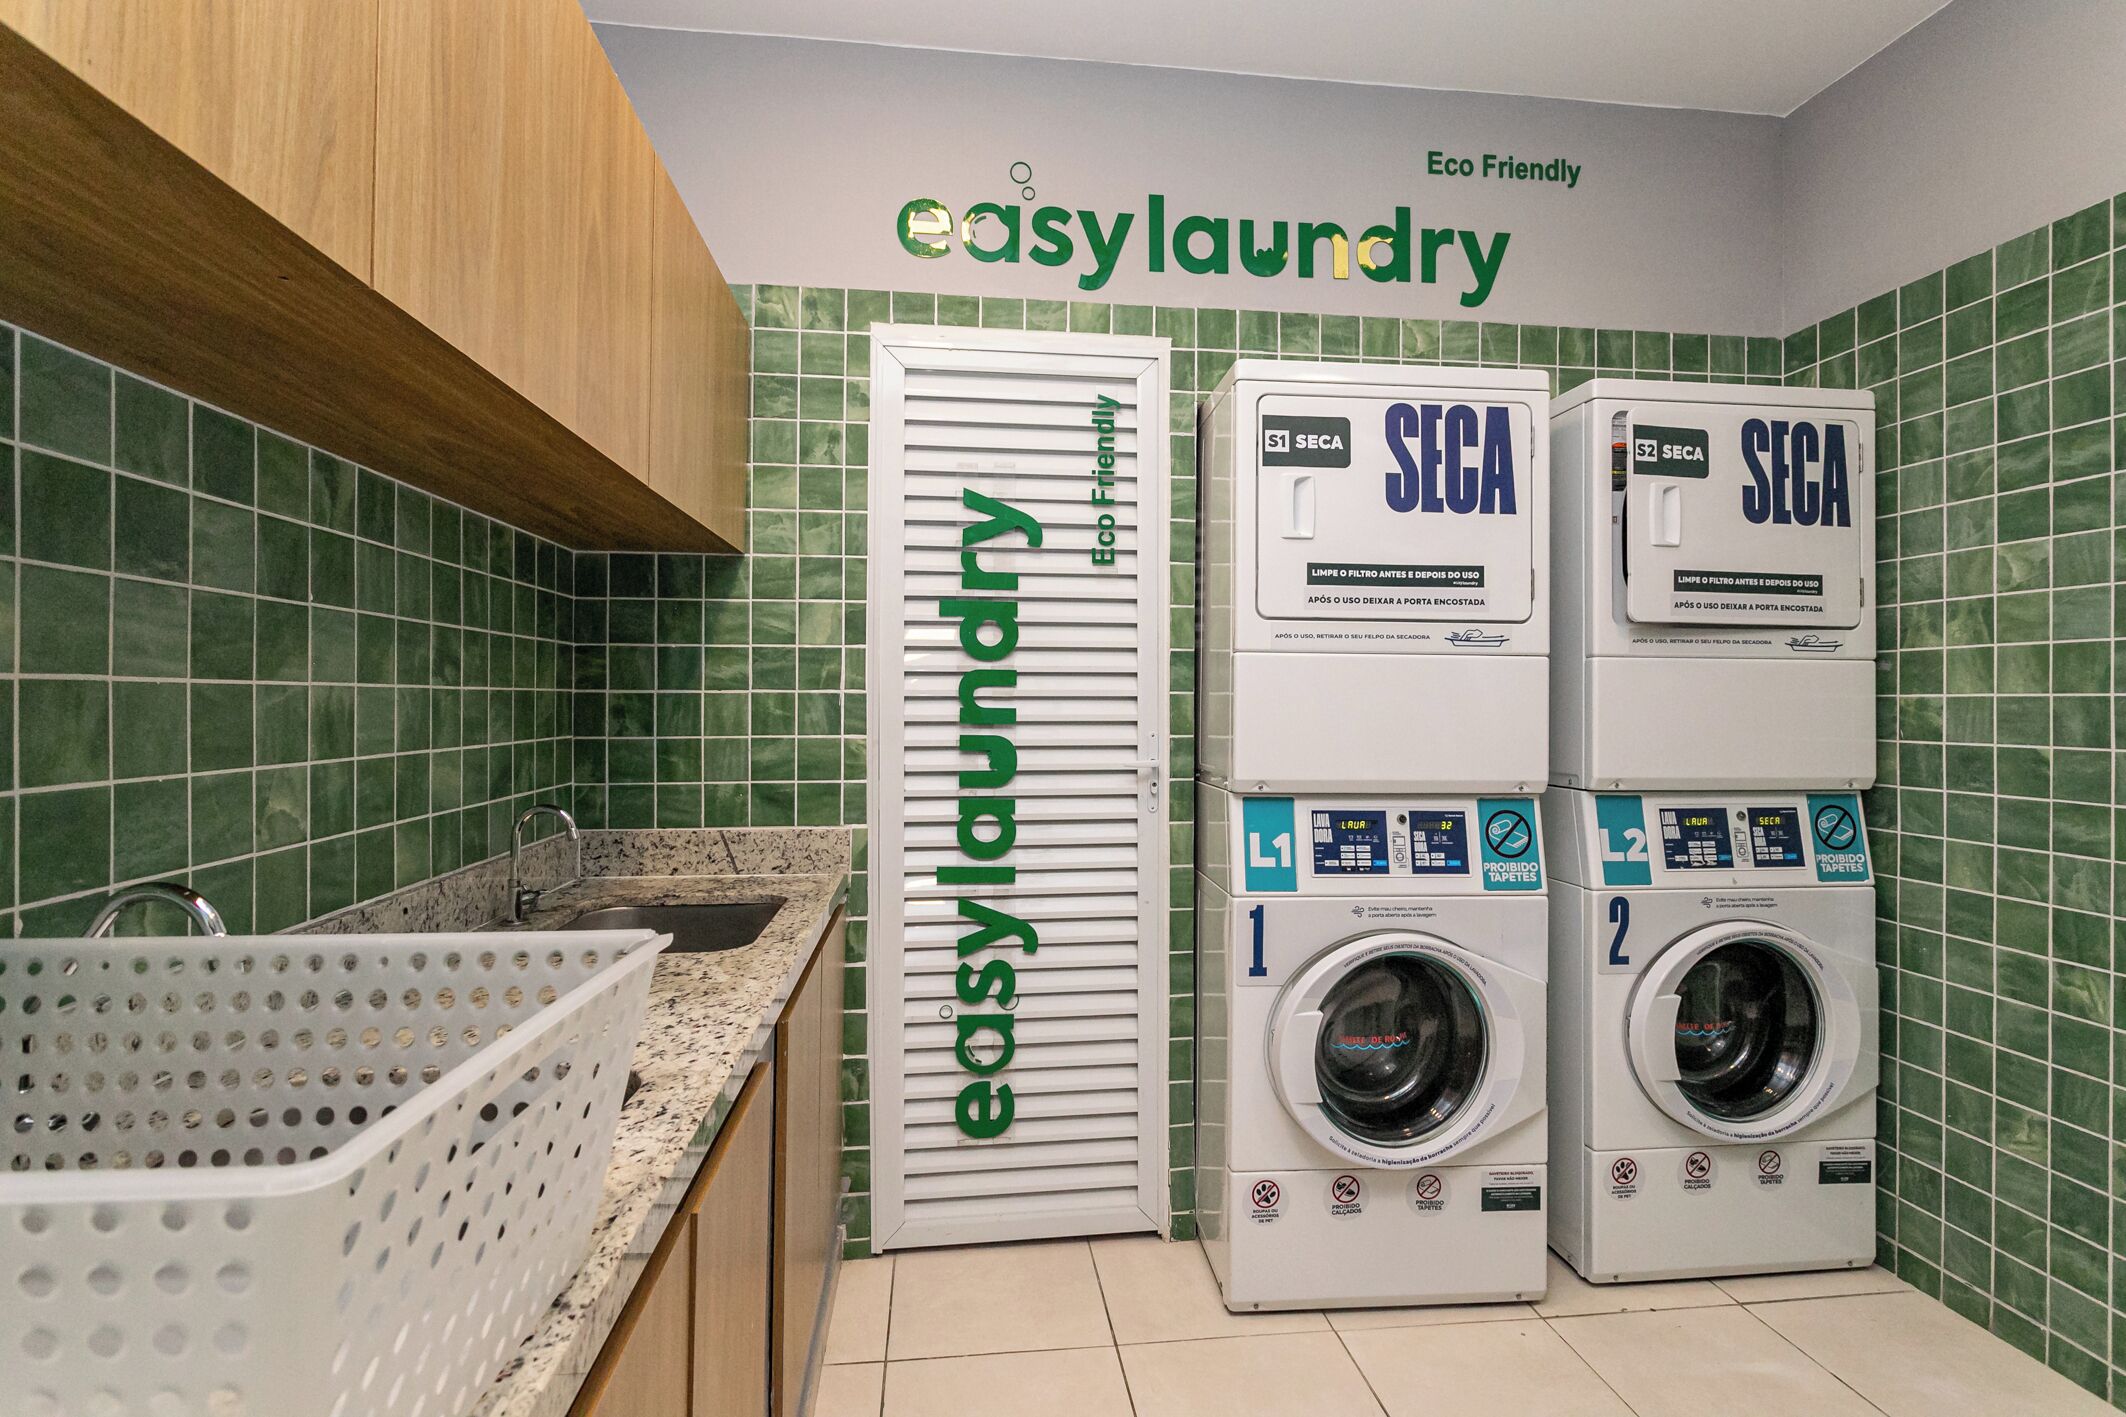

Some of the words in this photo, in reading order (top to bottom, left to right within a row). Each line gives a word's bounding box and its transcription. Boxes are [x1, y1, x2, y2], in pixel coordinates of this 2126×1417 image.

[1427, 151, 1475, 178] Eco
[1482, 154, 1581, 188] Friendly
[1092, 393, 1121, 506] Friendly
[1267, 434, 1287, 448] S1
[1295, 434, 1344, 450] SECA
[1385, 402, 1517, 515] SECA
[1636, 443, 1656, 458] S2
[1662, 445, 1704, 461] SECA
[1741, 418, 1851, 528] SECA
[1092, 513, 1116, 566] Eco
[1311, 568, 1338, 577] LIMPE
[1340, 569, 1347, 577] O
[1348, 570, 1378, 578] FILTRO
[1378, 570, 1407, 578] ANTES
[1415, 571, 1446, 579] DEPOIS
[1678, 576, 1701, 584] LIMPE
[1735, 578, 1758, 586] ANTES
[1308, 594, 1332, 604] APÓS
[1334, 596, 1341, 604] O
[1342, 596, 1361, 604] USO
[1434, 598, 1485, 606] ENCOSTADA
[1674, 600, 1694, 609] APÓS
[1313, 813, 1331, 828] LAVA
[1441, 821, 1453, 830] 32
[1760, 817, 1781, 825] SECA
[1249, 832, 1292, 868] L1
[1601, 828, 1649, 862] L2
[1816, 854, 1865, 863] PROIBIDO
[1483, 862, 1539, 872] PROIBIDO
[1820, 863, 1864, 872] TAPETES
[1488, 872, 1537, 882] TAPETES
[1608, 896, 1630, 966] 2
[1248, 904, 1268, 977] 1
[1332, 1208, 1362, 1216] CALÇADOS
